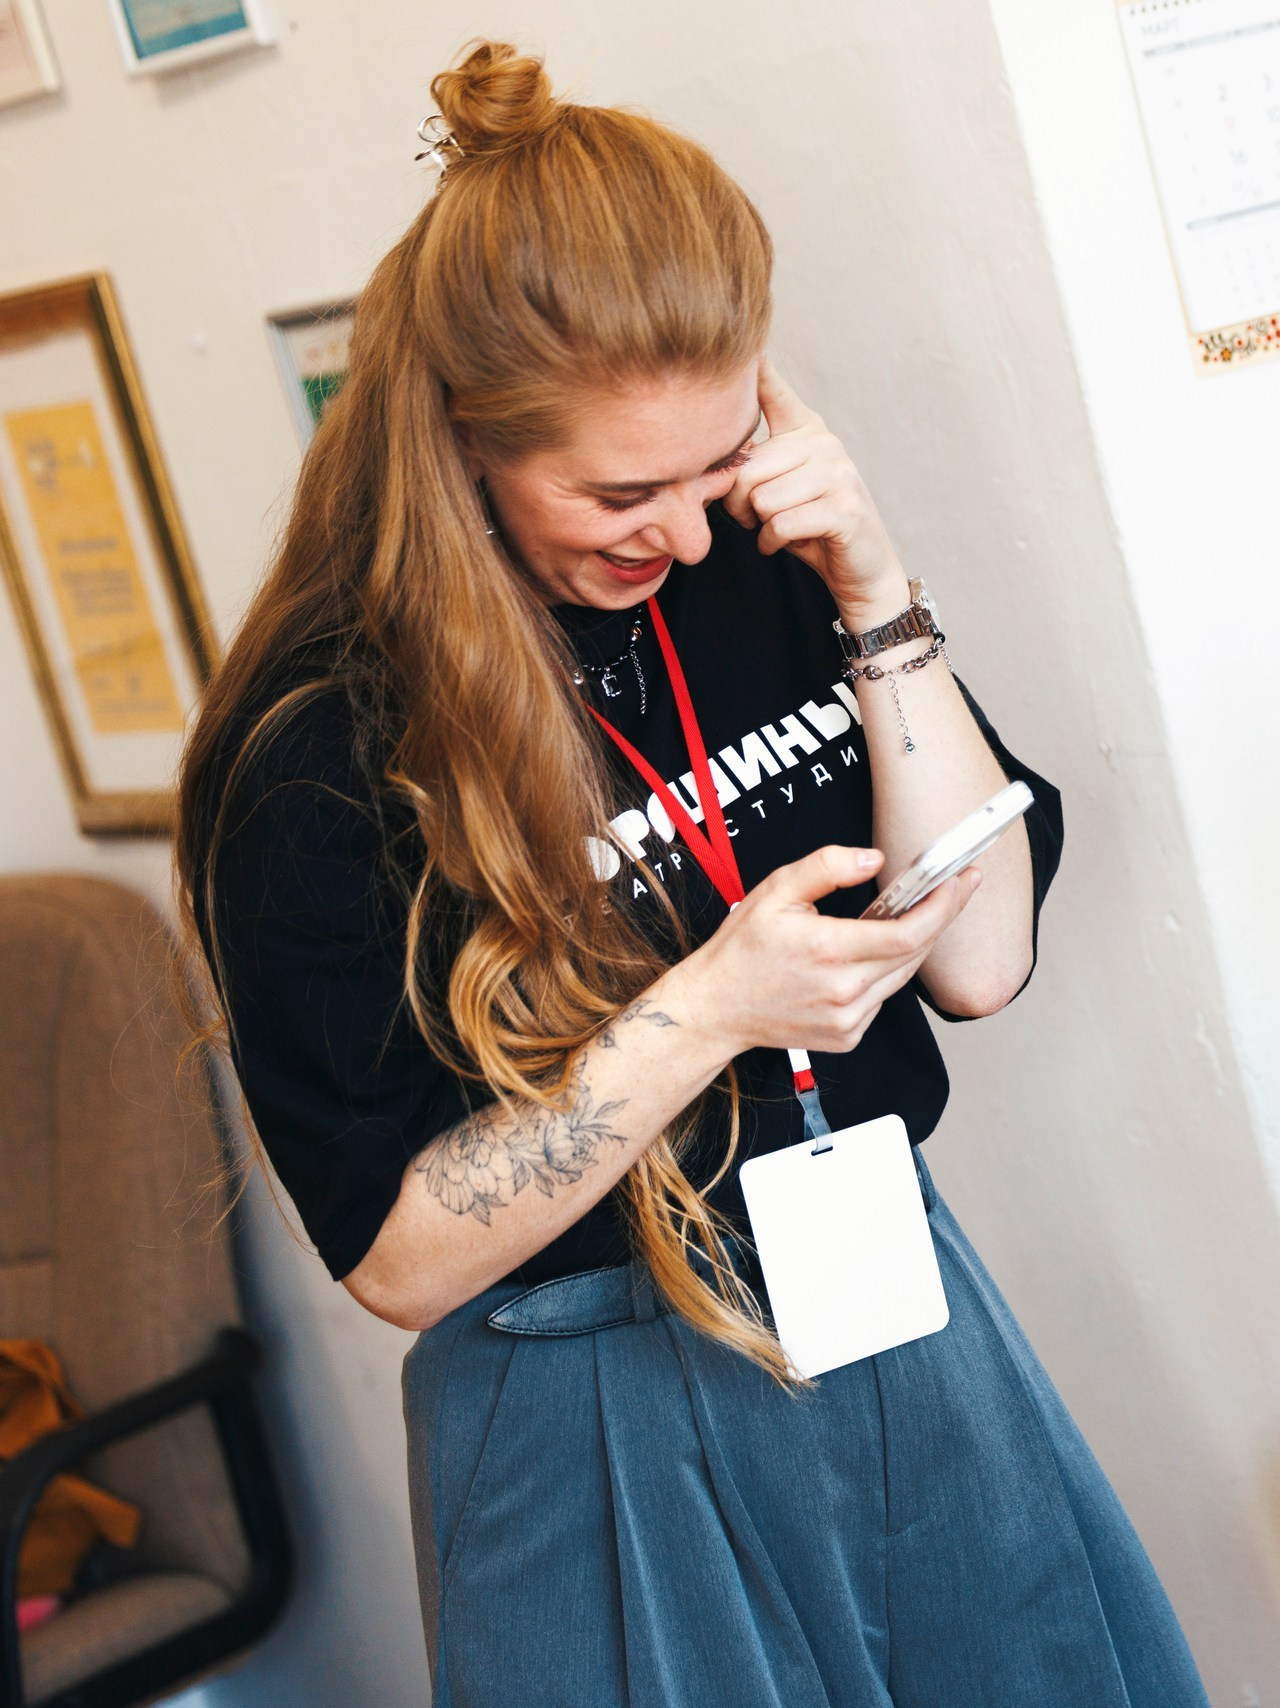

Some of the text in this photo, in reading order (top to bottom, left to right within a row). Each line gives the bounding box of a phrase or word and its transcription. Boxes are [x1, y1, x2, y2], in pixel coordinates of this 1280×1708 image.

[1217, 84, 1228, 103] 2
[1262, 73, 1273, 92] 3
[582, 681, 863, 883] ОРОШИНЫ
[725, 745, 859, 838] СТУДИ
